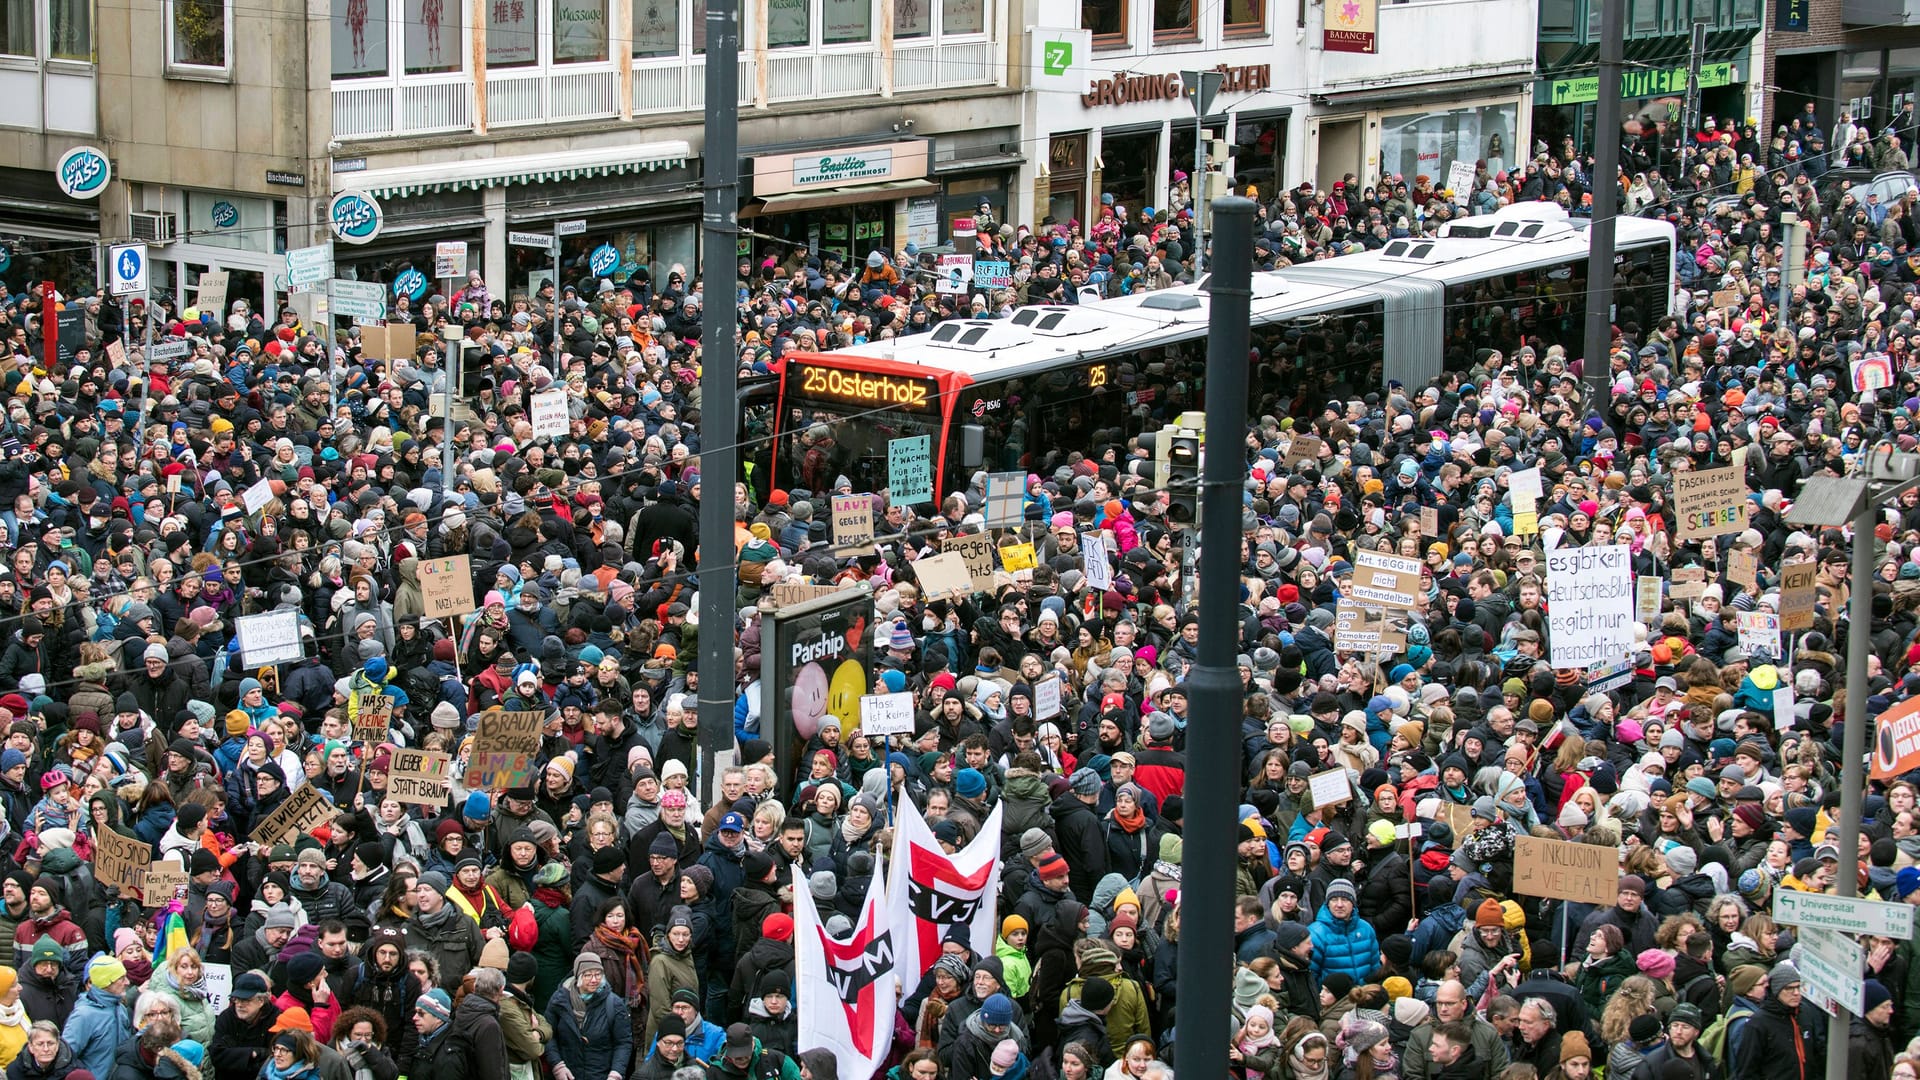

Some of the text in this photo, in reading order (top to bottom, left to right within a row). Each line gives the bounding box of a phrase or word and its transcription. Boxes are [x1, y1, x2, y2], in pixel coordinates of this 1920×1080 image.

[559, 7, 601, 24] Massage
[1330, 31, 1367, 40] BALANCE
[1052, 48, 1065, 69] Z
[1082, 64, 1271, 108] GRÖNING ÄTJEN
[1574, 80, 1600, 94] Unterwe
[65, 155, 85, 176] vom
[819, 155, 867, 174] Basilico
[66, 156, 101, 194] FASS
[266, 172, 304, 186] Bischofsnadel
[799, 172, 843, 184] ANTIPASTI
[849, 167, 888, 178] FEINKOST
[214, 206, 234, 227] FASS
[337, 200, 355, 217] vom
[336, 203, 371, 236] FASS
[512, 234, 550, 246] Bischofsnadel
[591, 250, 605, 264] vom
[592, 247, 616, 278] FASS
[120, 281, 139, 291] ZONE
[154, 344, 185, 357] Bischofsnadel
[1091, 365, 1106, 387] 25
[803, 366, 927, 407] 25 Osterholz
[986, 399, 1001, 411] BSAG
[1679, 471, 1735, 491] FASCHISMUS
[836, 500, 869, 512] LAUT
[839, 516, 867, 527] GEGEN
[1185, 535, 1192, 548] 3
[1358, 554, 1418, 574] Art. 16 GG ist
[1569, 547, 1598, 575] gibt
[1373, 574, 1395, 587] nicht
[1784, 571, 1813, 590] KEIN
[1354, 588, 1414, 605] verhandelbar
[1338, 621, 1350, 630] die
[1565, 606, 1594, 636] gibt
[1597, 611, 1626, 630] nur
[793, 631, 845, 666] Parship
[362, 695, 387, 707] HASS
[869, 697, 894, 710] Hass
[372, 707, 380, 715] IST
[869, 709, 911, 723] ist keine
[358, 714, 387, 728] KEINE
[481, 711, 544, 738] BRAUN
[353, 727, 386, 742] MEINUNG
[394, 752, 422, 773] LIEBER
[391, 777, 448, 800] STATT BRAUN
[258, 786, 316, 844] NIE WIEDER
[98, 829, 151, 866] NAZIS SIND
[1542, 842, 1602, 871] INKLUSION
[145, 873, 189, 886] Kein Mensch
[1542, 870, 1616, 900] VIELFALT
[148, 889, 172, 905] Illega
[1799, 897, 1856, 914] Universität
[1799, 911, 1868, 929] Schwachhausen
